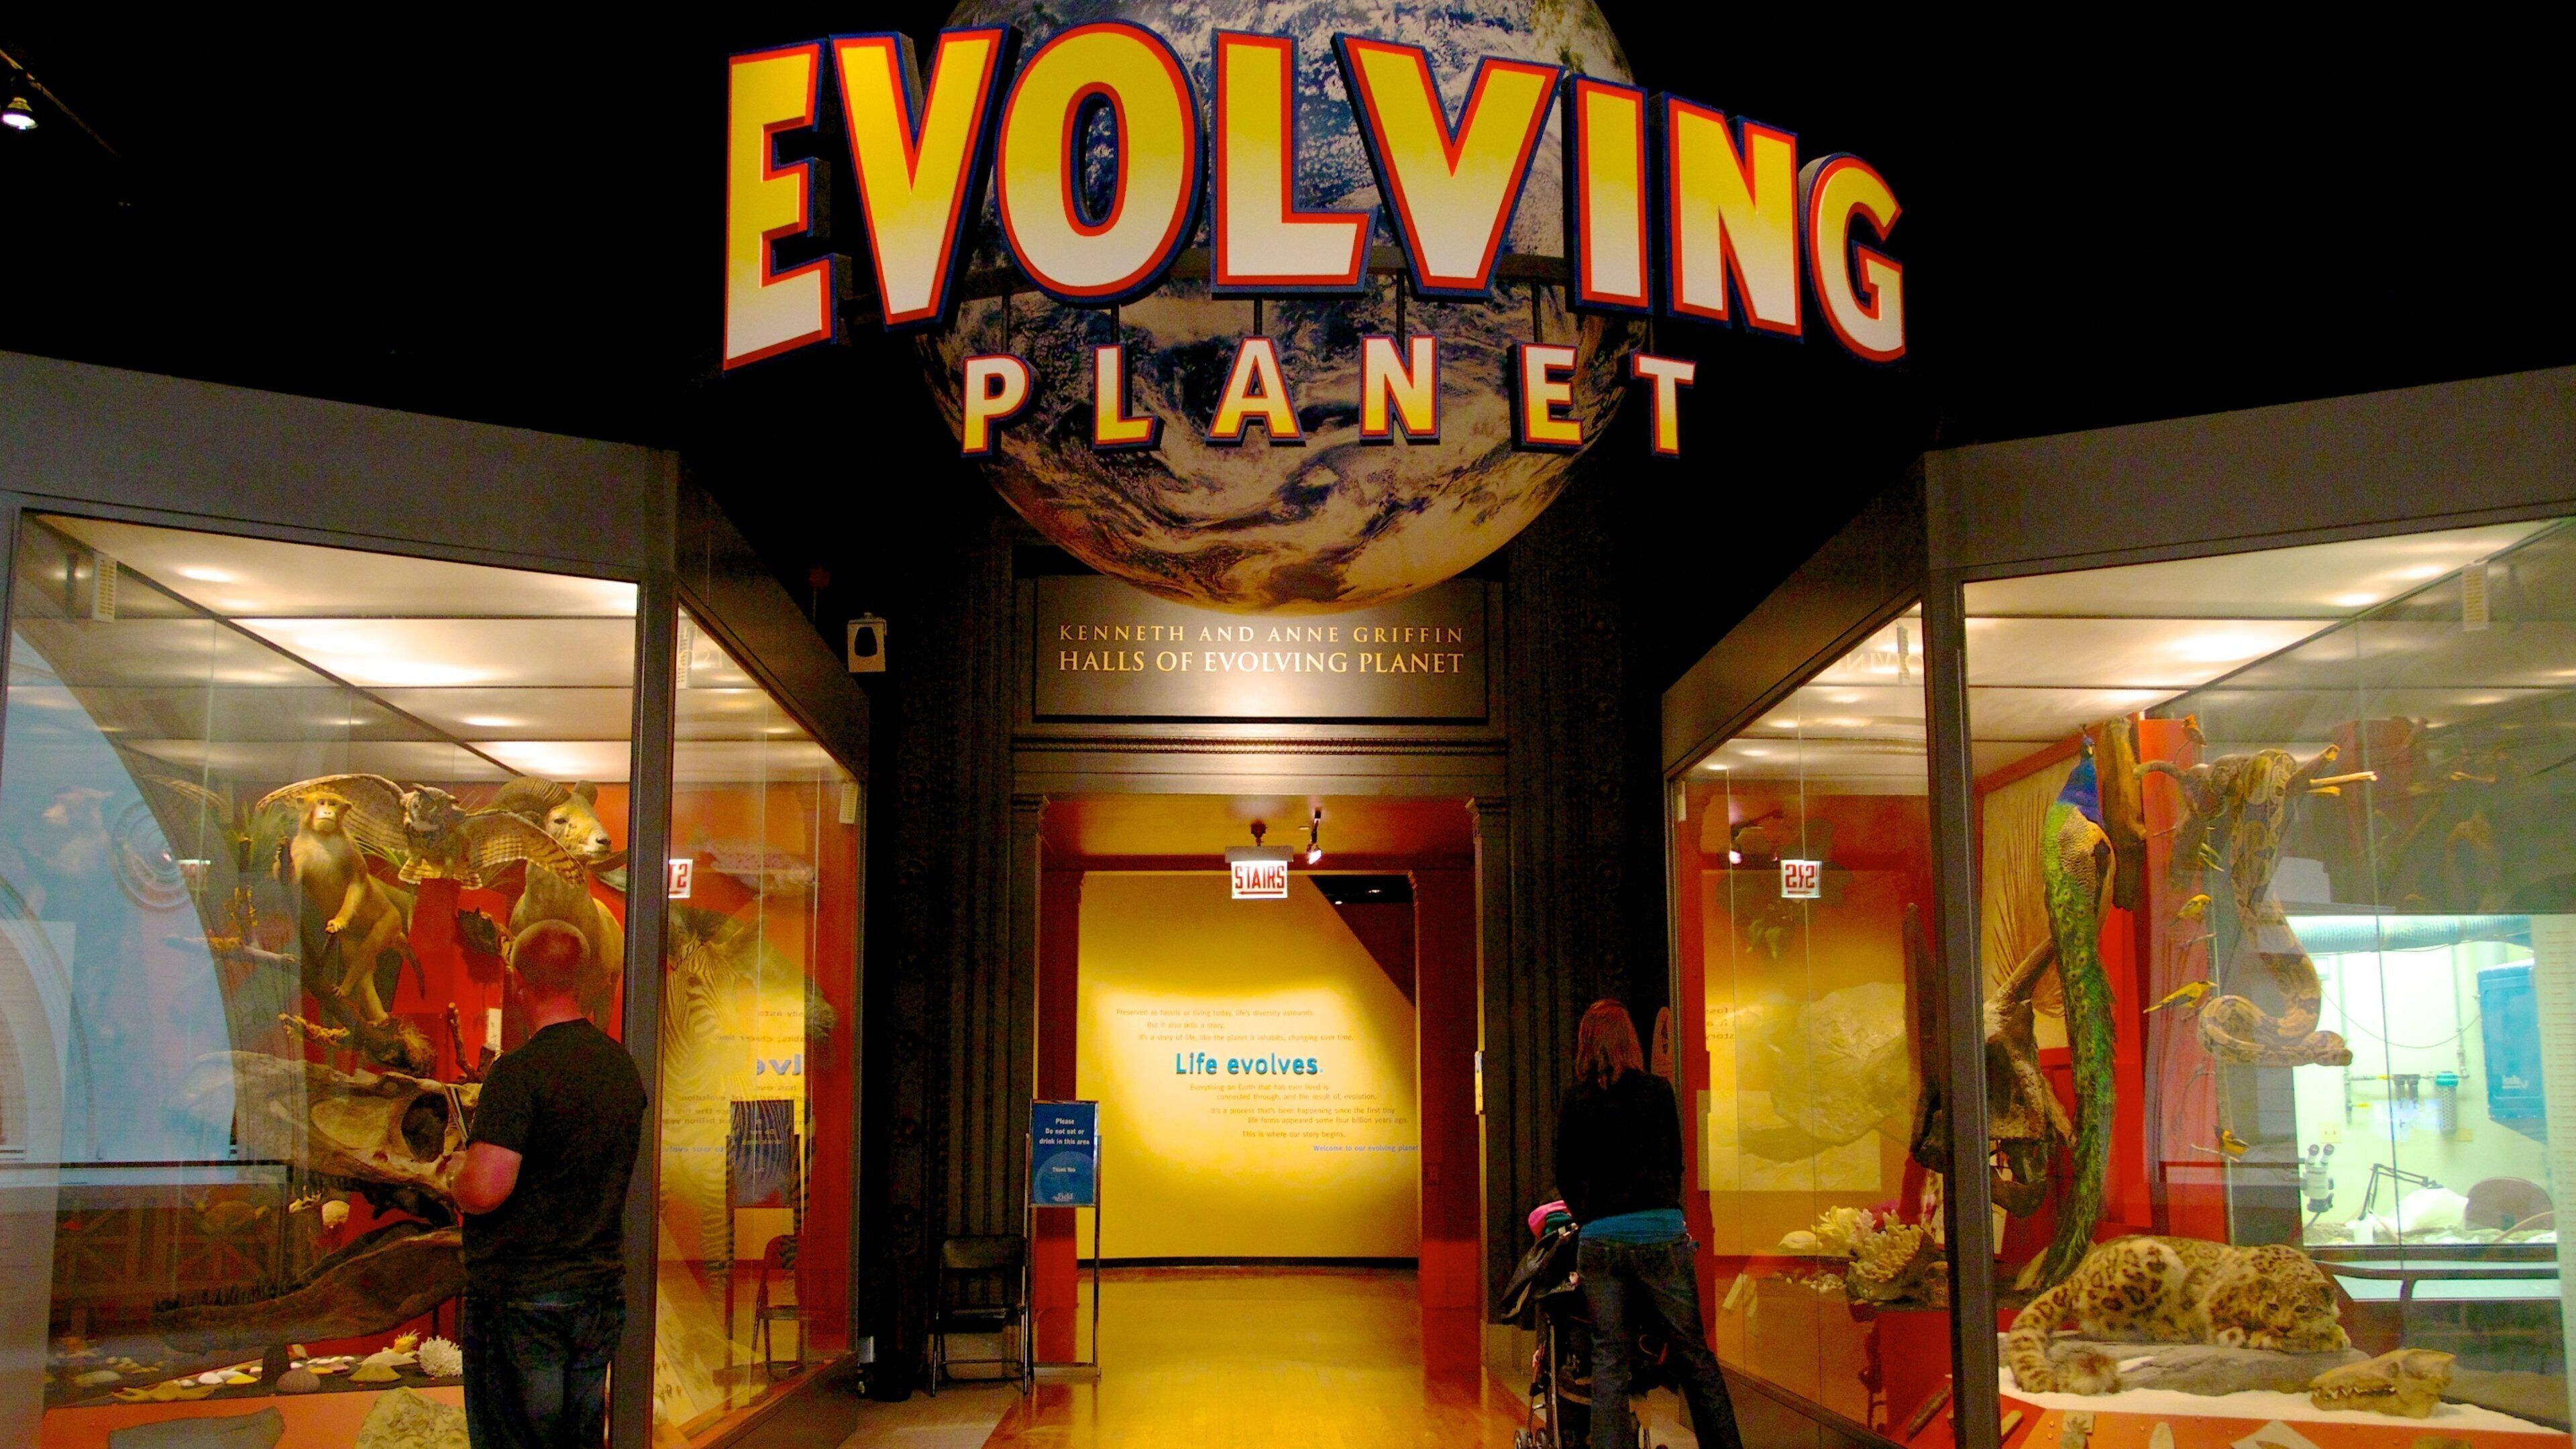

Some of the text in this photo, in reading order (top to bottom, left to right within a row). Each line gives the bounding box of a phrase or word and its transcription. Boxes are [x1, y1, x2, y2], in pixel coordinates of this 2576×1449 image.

[723, 19, 1907, 374] EVOLVING
[961, 335, 1697, 456] PLANET
[1060, 625, 1462, 643] KENNETH AND ANNE GRIFFIN
[1059, 651, 1463, 673] HALLS OF EVOLVING PLANET
[1235, 865, 1285, 889] STAIRS
[1193, 1009, 1211, 1018] living
[1253, 1010, 1280, 1018] diversity
[1227, 1034, 1247, 1042] planet
[1288, 1034, 1318, 1042] changing
[1176, 1052, 1324, 1075] Life evolves.
[1297, 1107, 1332, 1115] happening
